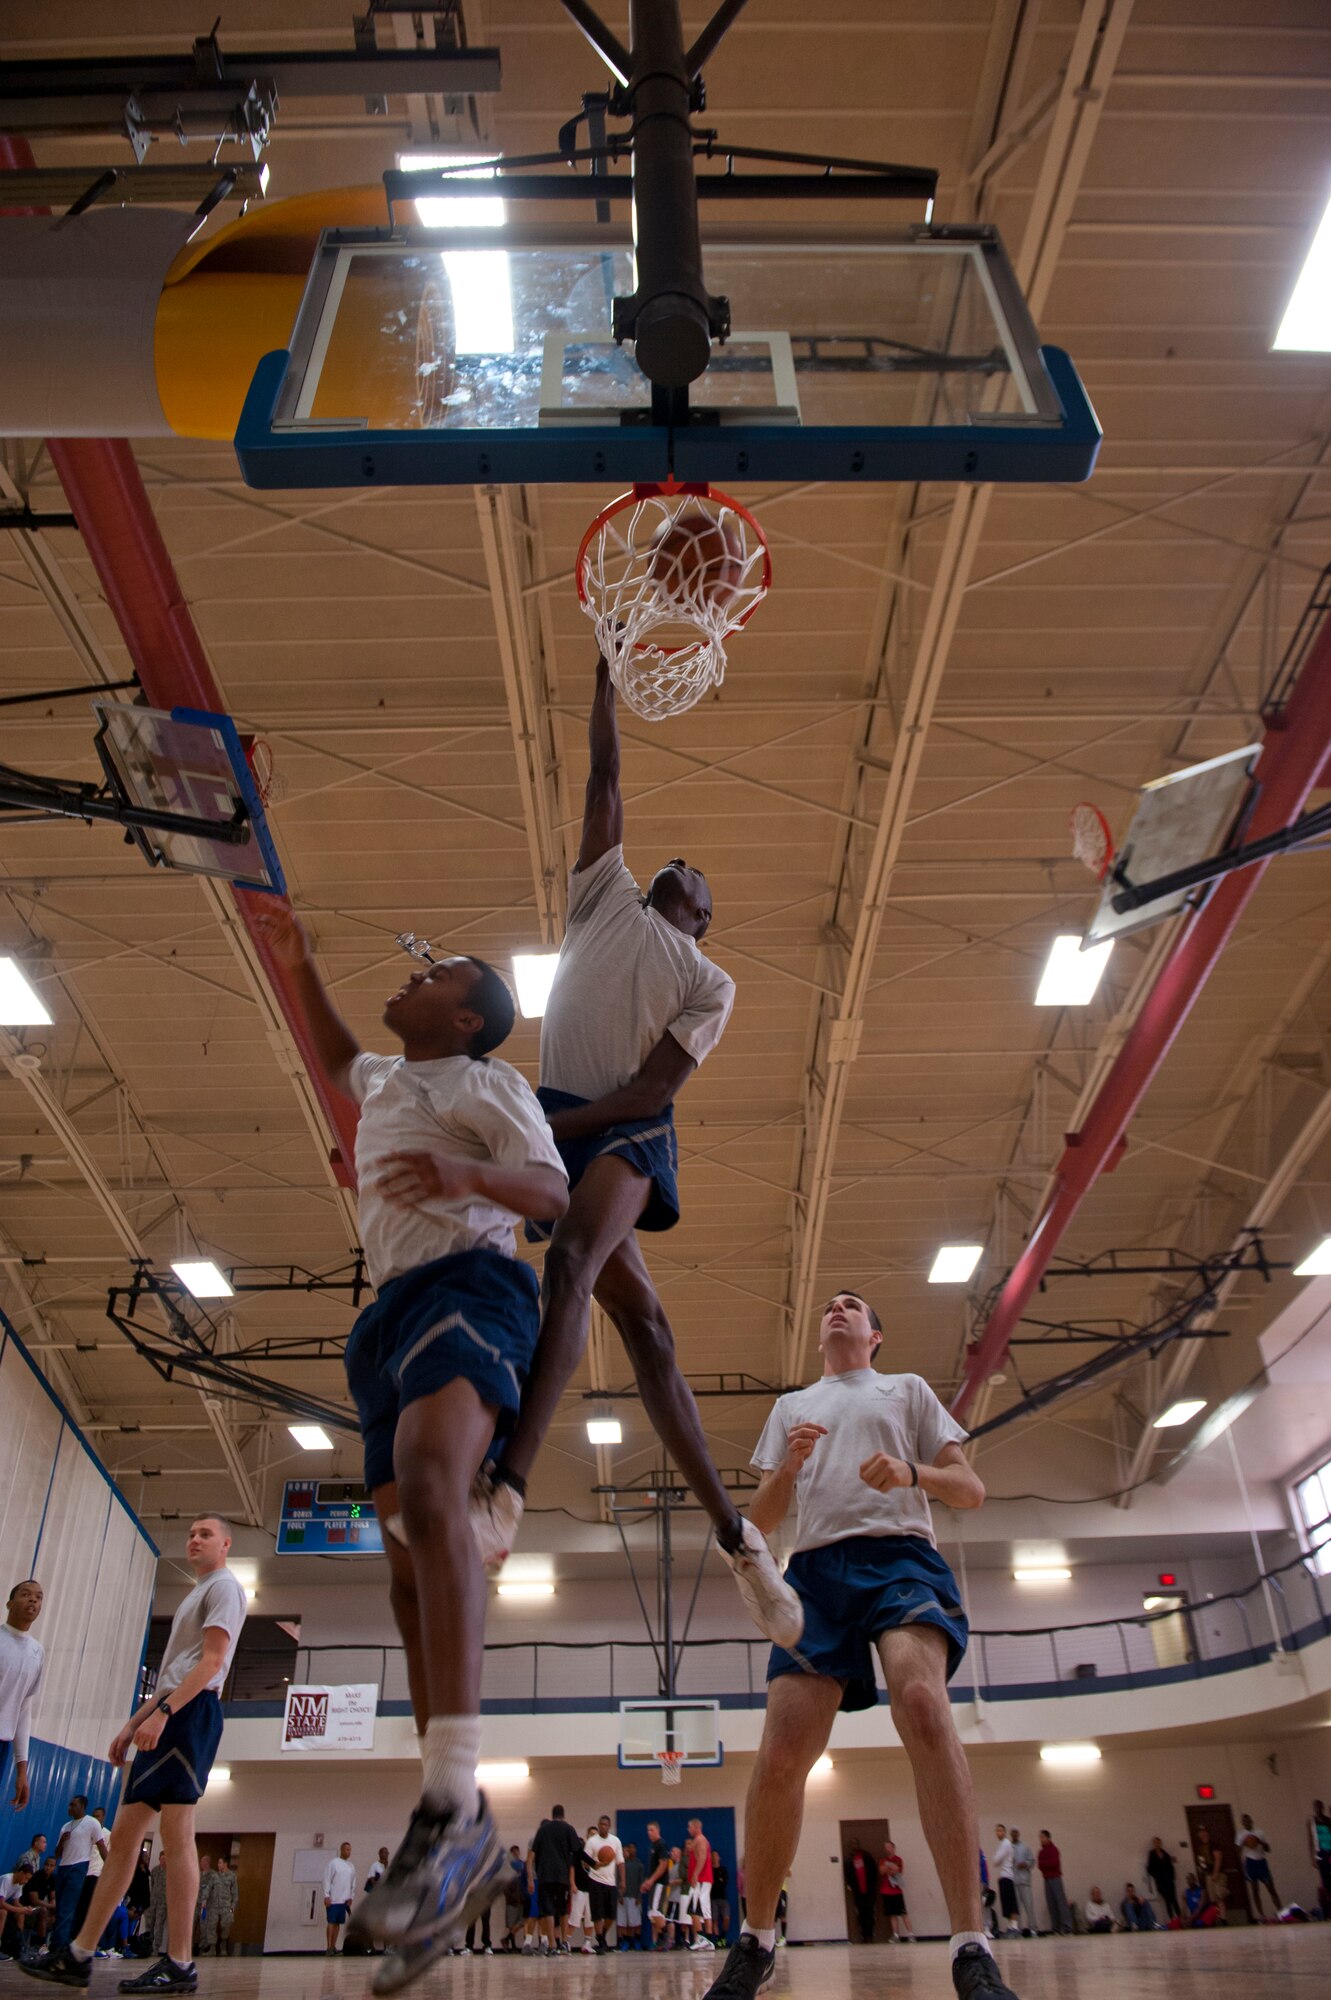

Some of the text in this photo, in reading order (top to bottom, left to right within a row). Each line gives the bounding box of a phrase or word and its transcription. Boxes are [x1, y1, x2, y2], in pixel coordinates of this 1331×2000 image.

[287, 1482, 315, 1491] HOME
[292, 1510, 313, 1518] BONUS
[287, 1522, 306, 1530] FOULS
[324, 1521, 370, 1529] PLAYER FOULS
[290, 1696, 328, 1716] NM
[288, 1716, 327, 1727] STATE
